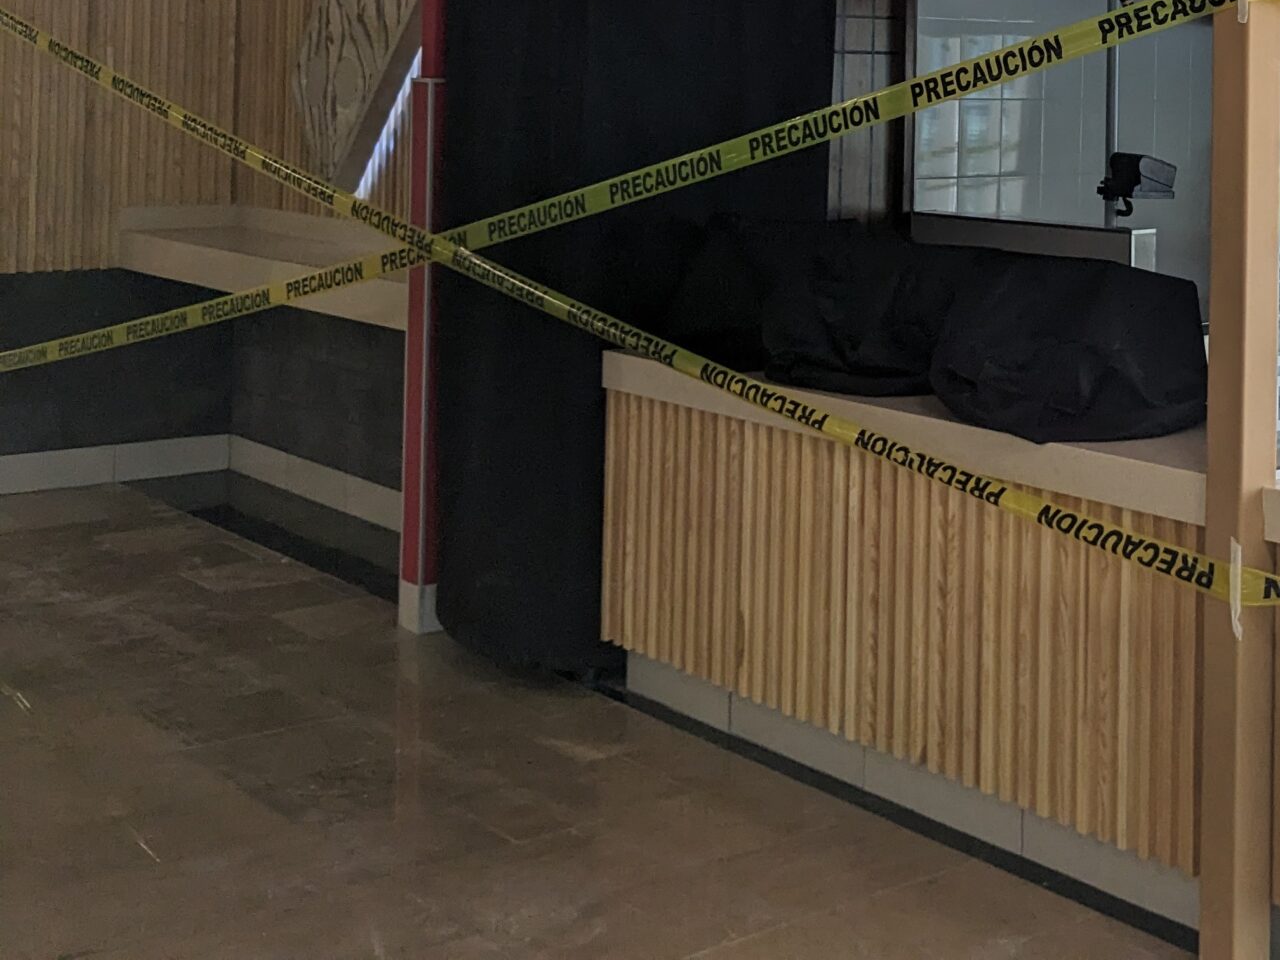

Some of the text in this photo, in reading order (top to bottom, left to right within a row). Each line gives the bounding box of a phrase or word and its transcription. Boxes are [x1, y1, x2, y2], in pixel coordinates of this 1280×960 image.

[488, 193, 586, 242] PRECAUCIÓN
[609, 149, 722, 204] PRECAUCIÓN
[749, 96, 880, 160] PRECAUCIÓN
[911, 34, 1063, 107] PRECAUCIÓN
